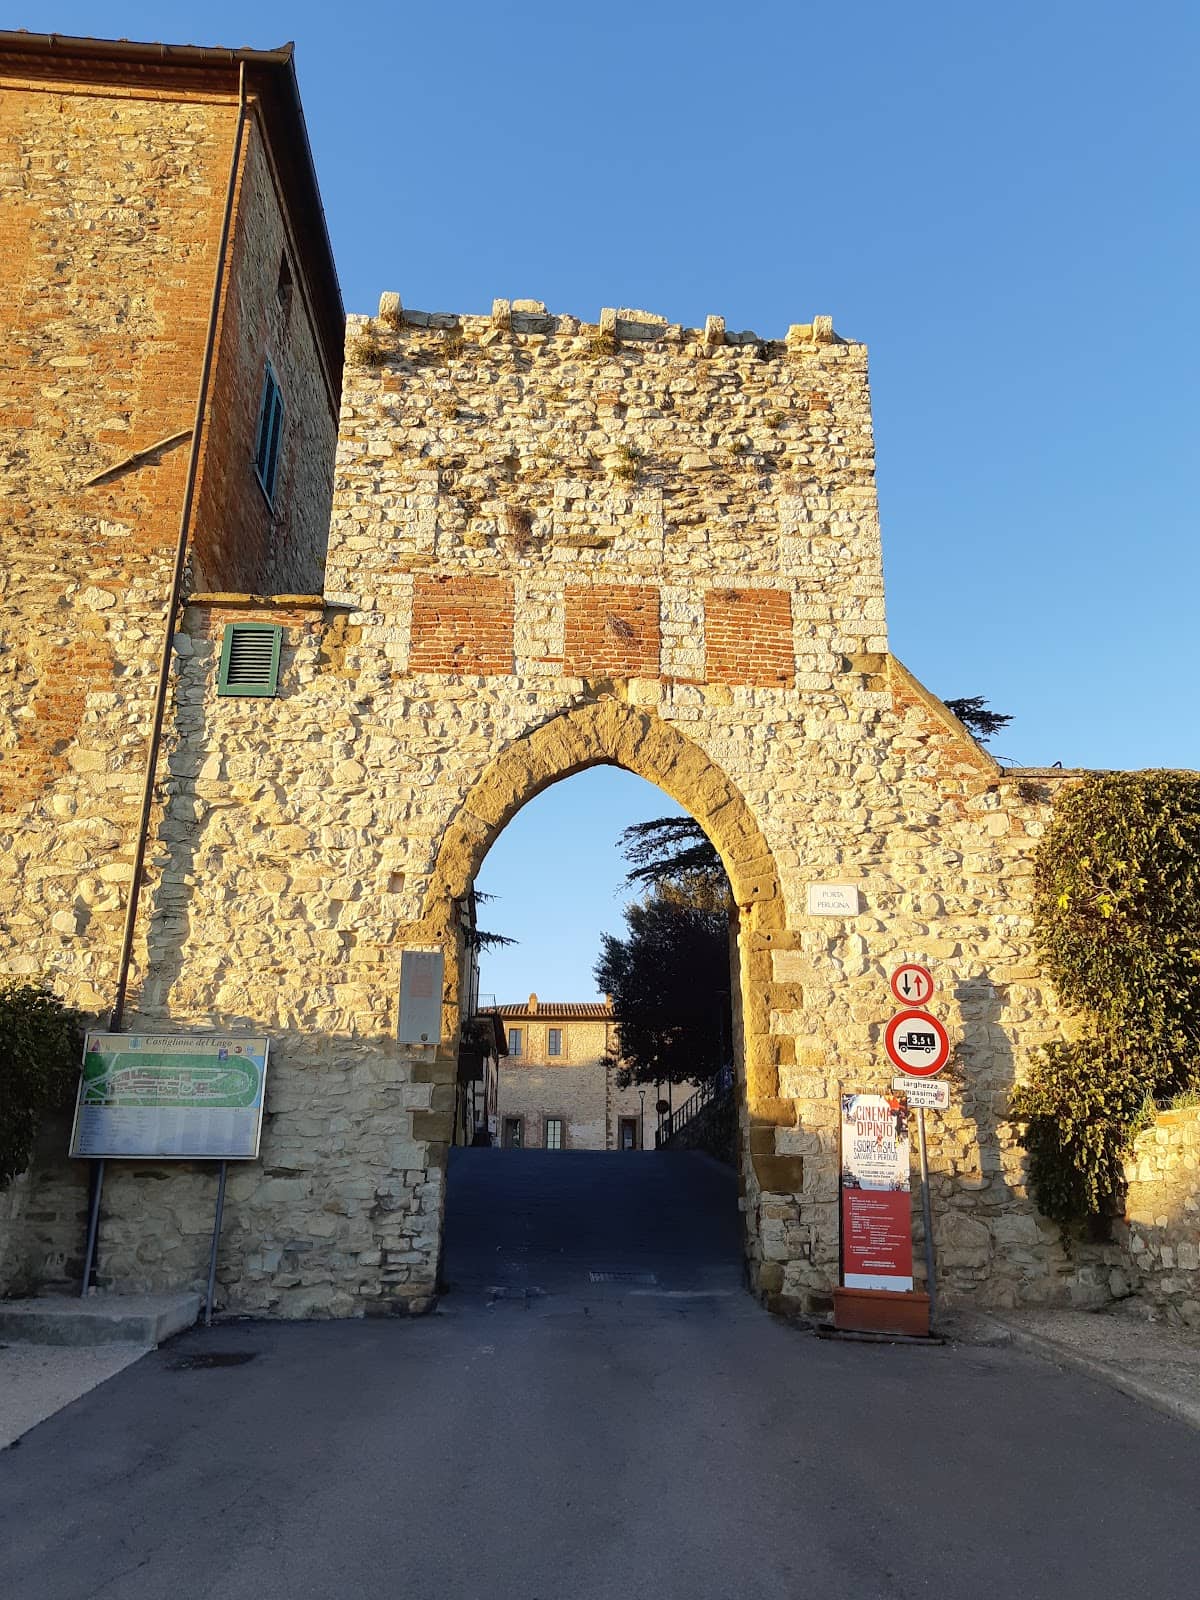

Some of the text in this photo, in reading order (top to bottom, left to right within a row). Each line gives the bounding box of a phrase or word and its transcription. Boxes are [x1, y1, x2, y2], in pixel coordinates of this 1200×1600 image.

[145, 1038, 233, 1048] Castiglione del Lago
[856, 1106, 893, 1121] CINEMA
[857, 1121, 893, 1137] DIPINTO
